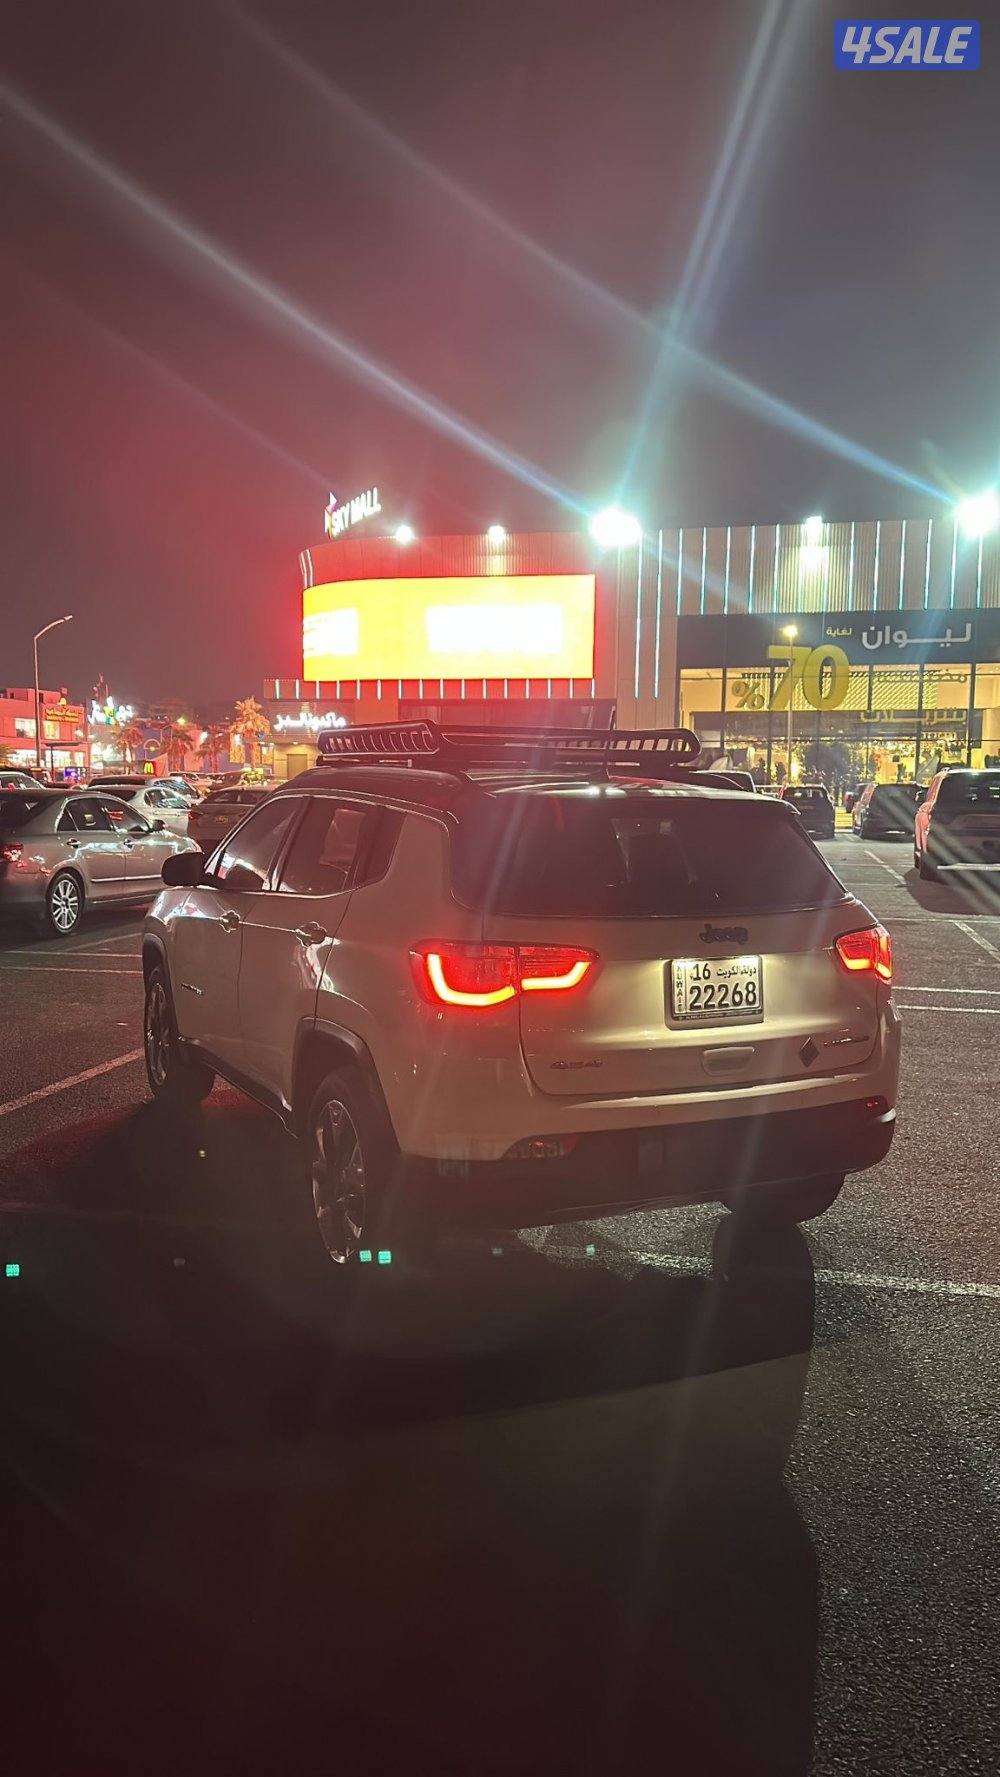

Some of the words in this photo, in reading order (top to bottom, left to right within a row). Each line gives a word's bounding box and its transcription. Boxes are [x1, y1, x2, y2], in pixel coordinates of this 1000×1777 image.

[862, 623, 972, 649] ليوان
[699, 923, 748, 945] Jeep
[692, 963, 711, 981] 16
[689, 981, 757, 1010] 22268
